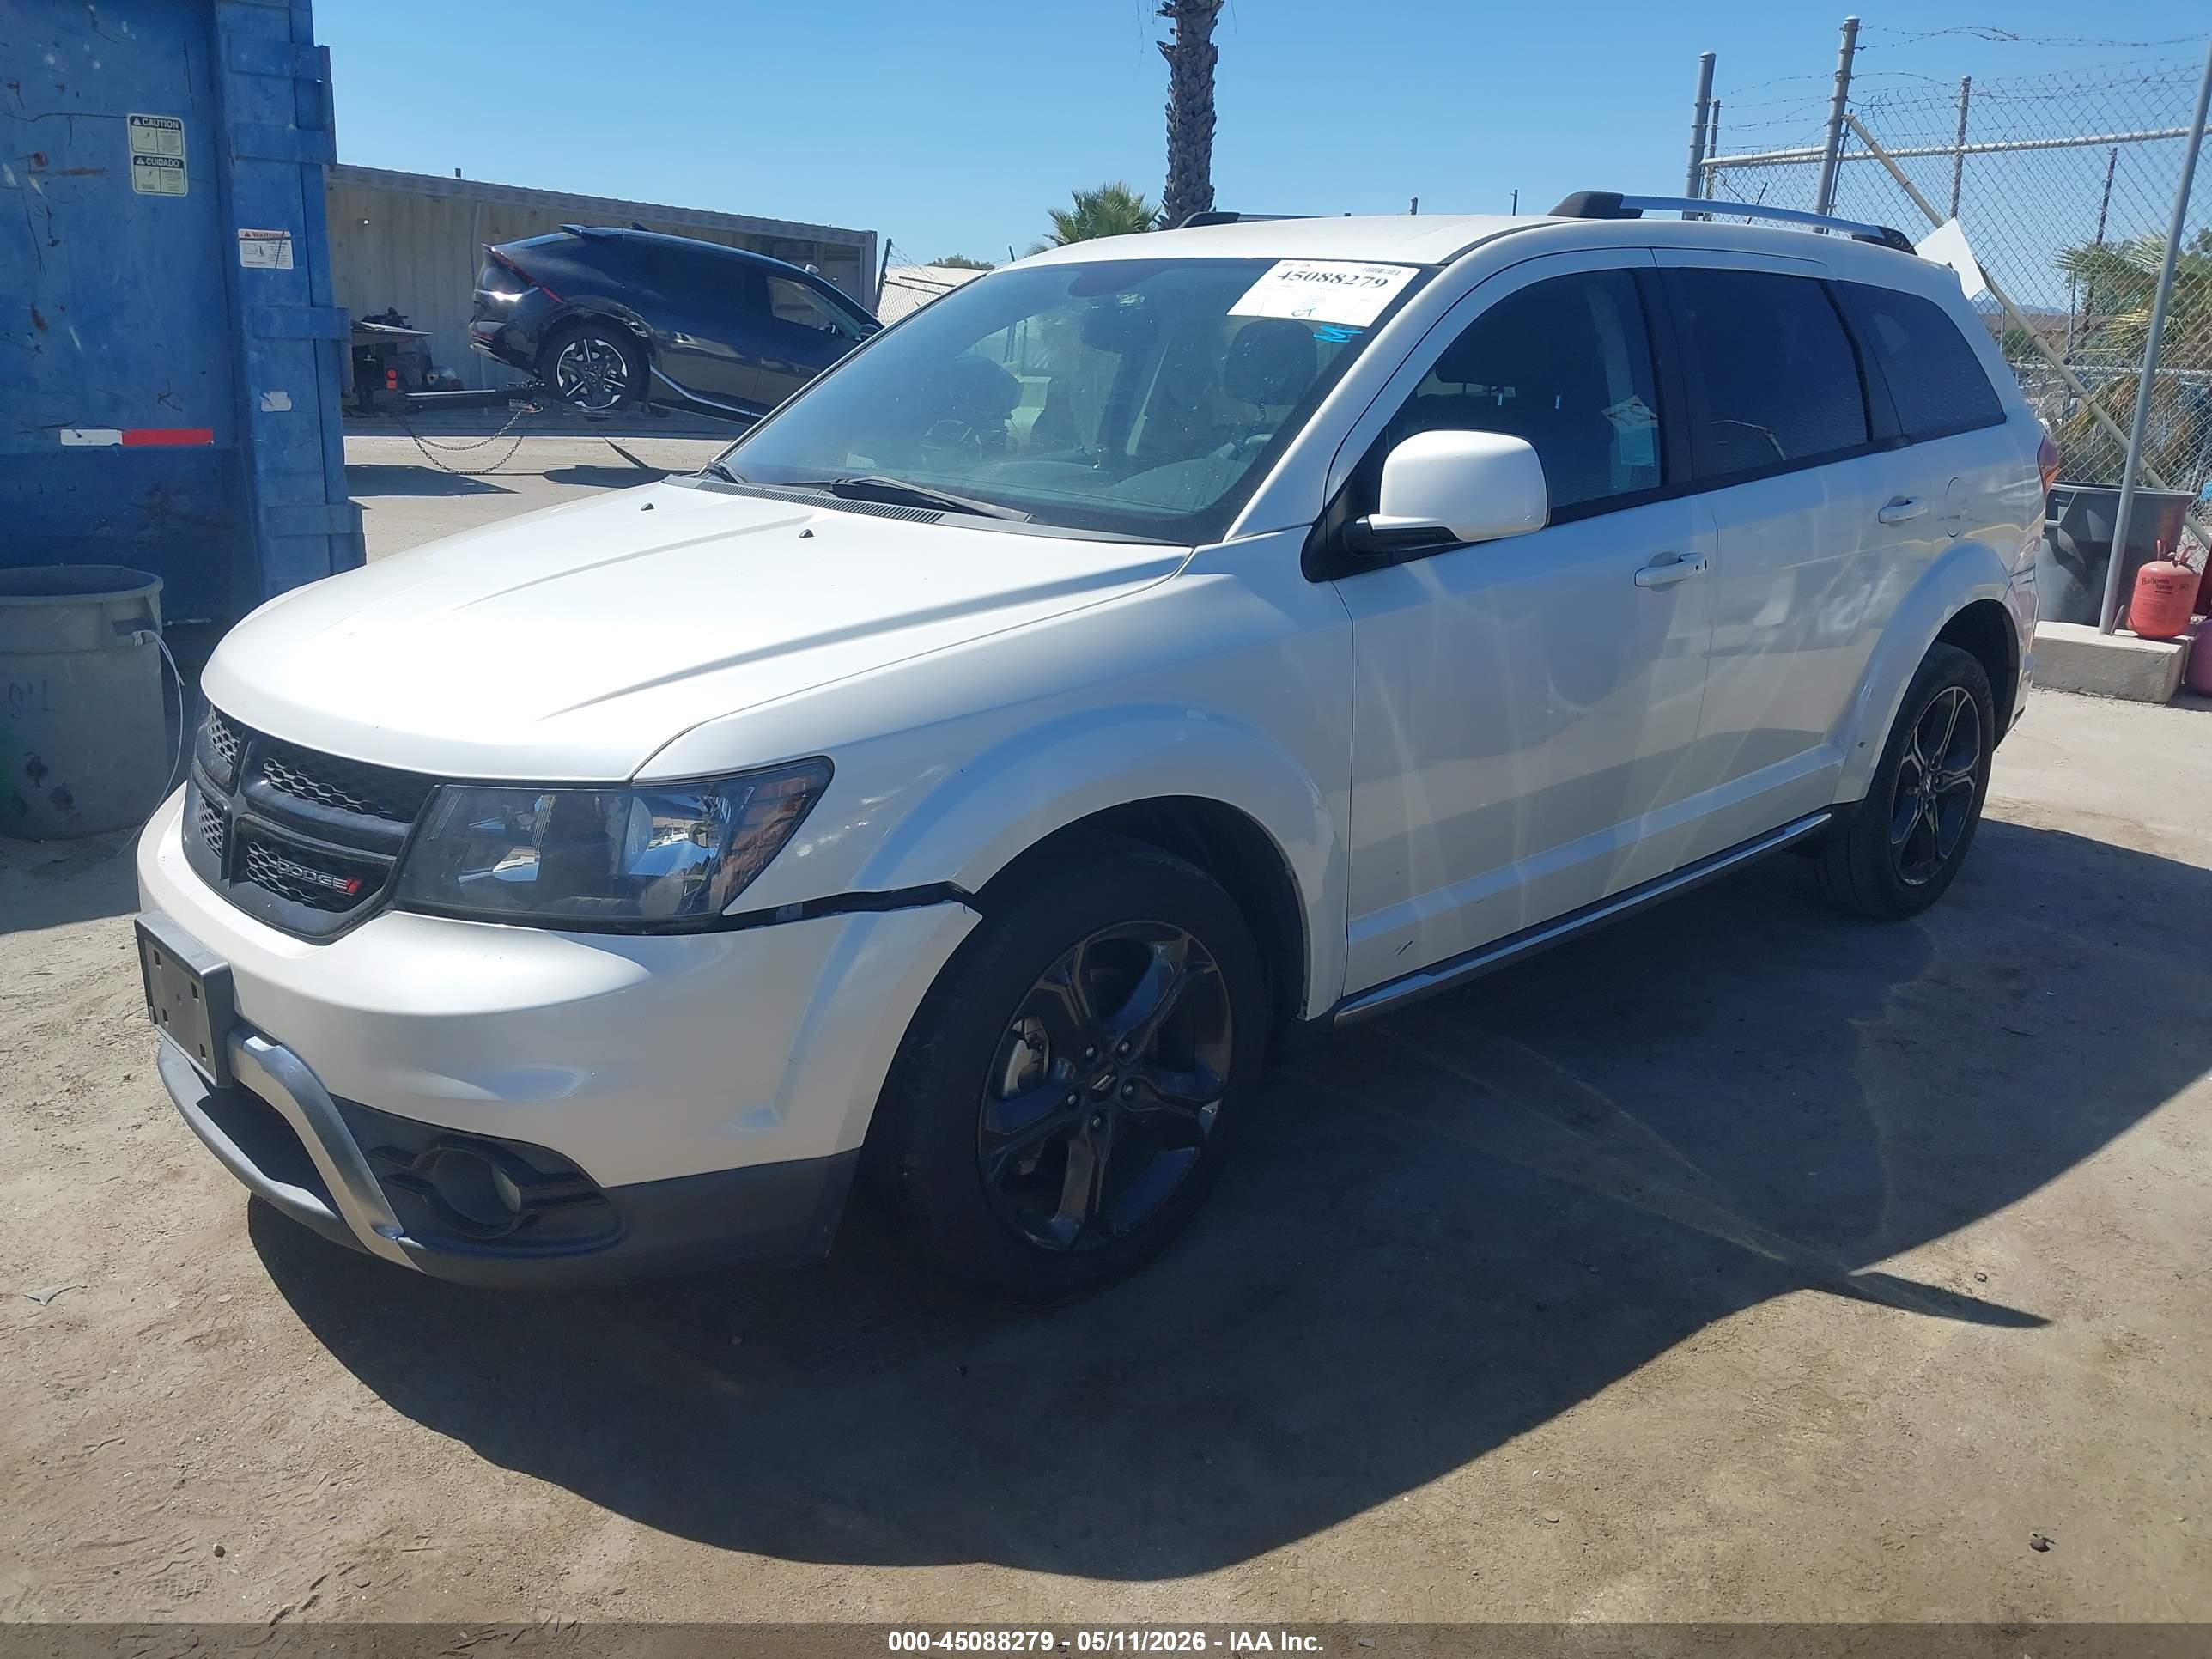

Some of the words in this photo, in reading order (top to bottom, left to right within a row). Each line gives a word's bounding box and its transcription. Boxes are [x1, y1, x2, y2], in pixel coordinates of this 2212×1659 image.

[142, 118, 179, 129] CAUTION
[145, 157, 179, 167] CUIDADO
[1276, 270, 1389, 289] 45088279
[276, 860, 348, 890] DODGE
